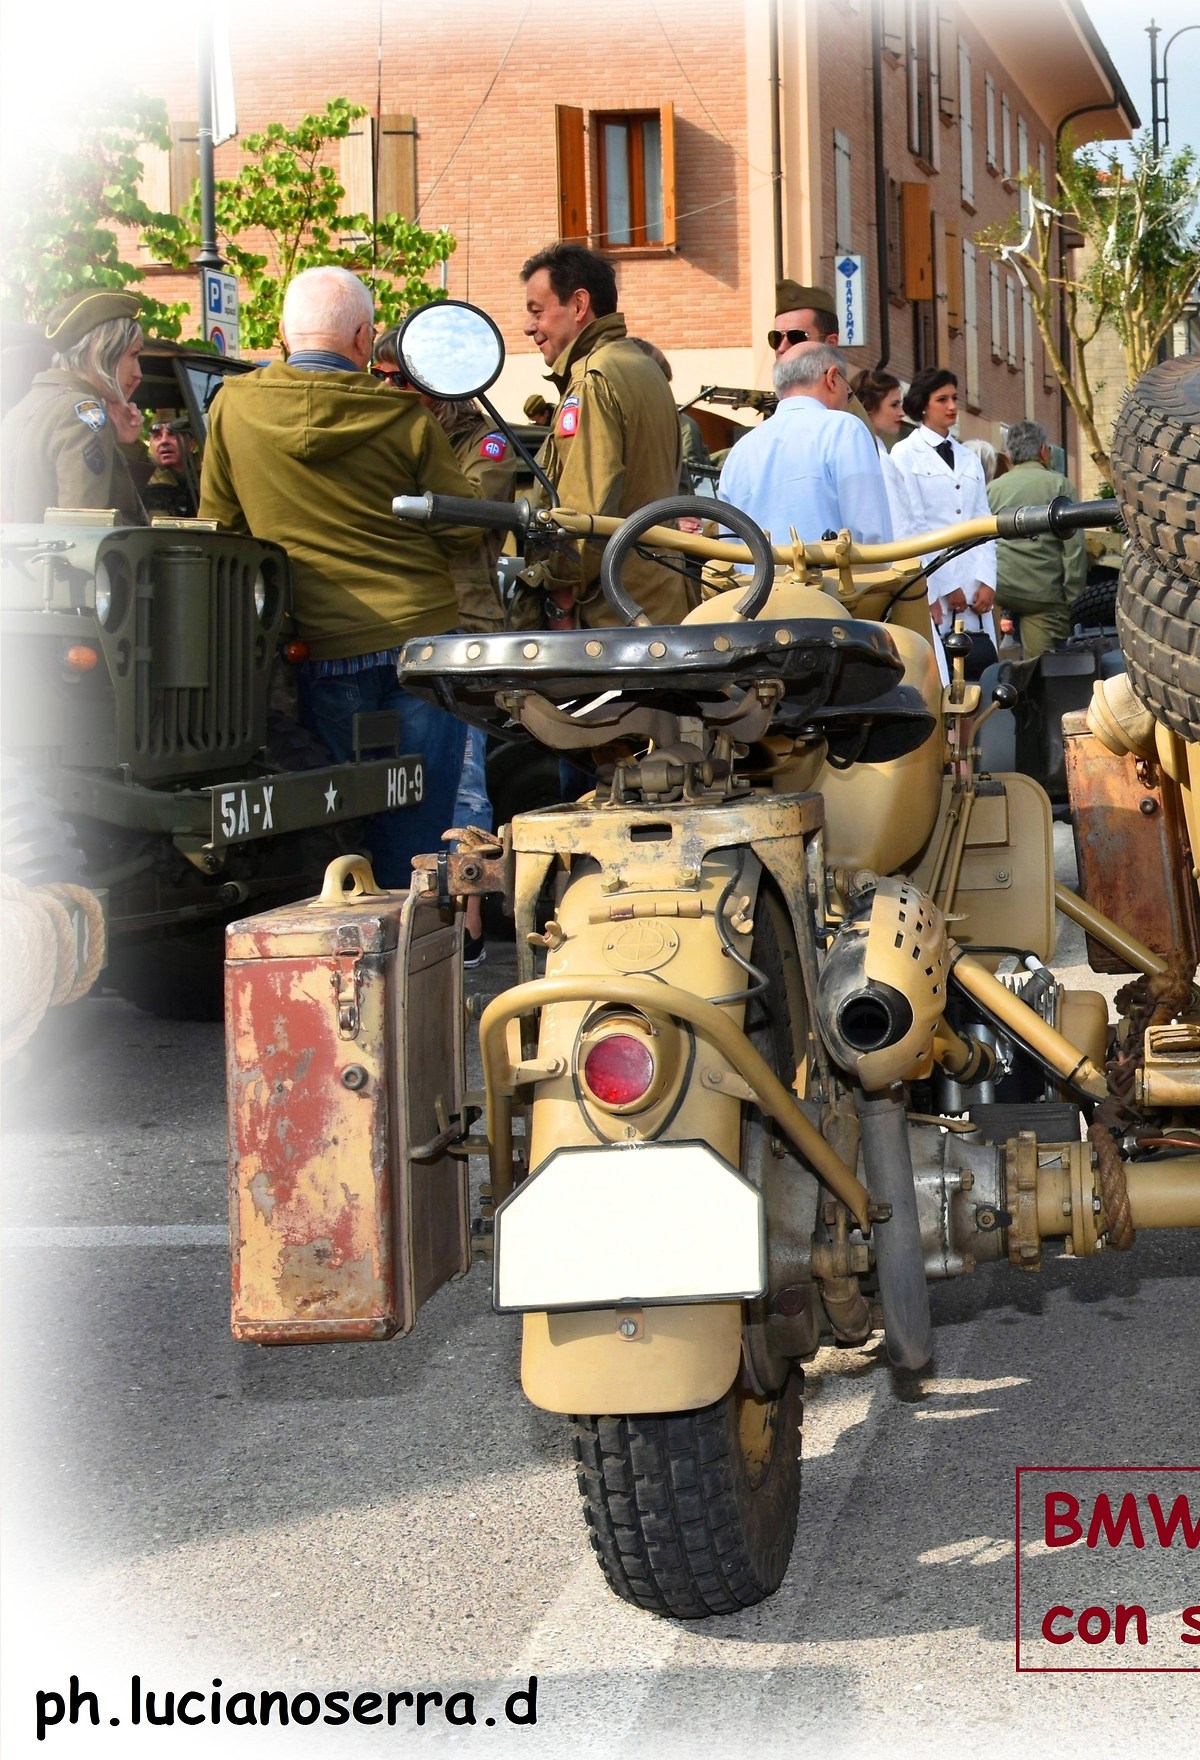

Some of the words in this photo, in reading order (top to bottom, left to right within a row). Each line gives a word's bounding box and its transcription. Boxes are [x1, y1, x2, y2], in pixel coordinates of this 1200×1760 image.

[210, 282, 220, 308] P
[846, 280, 854, 344] BANCOMAT
[387, 764, 423, 807] HQ-9
[221, 785, 274, 838] 5A-X
